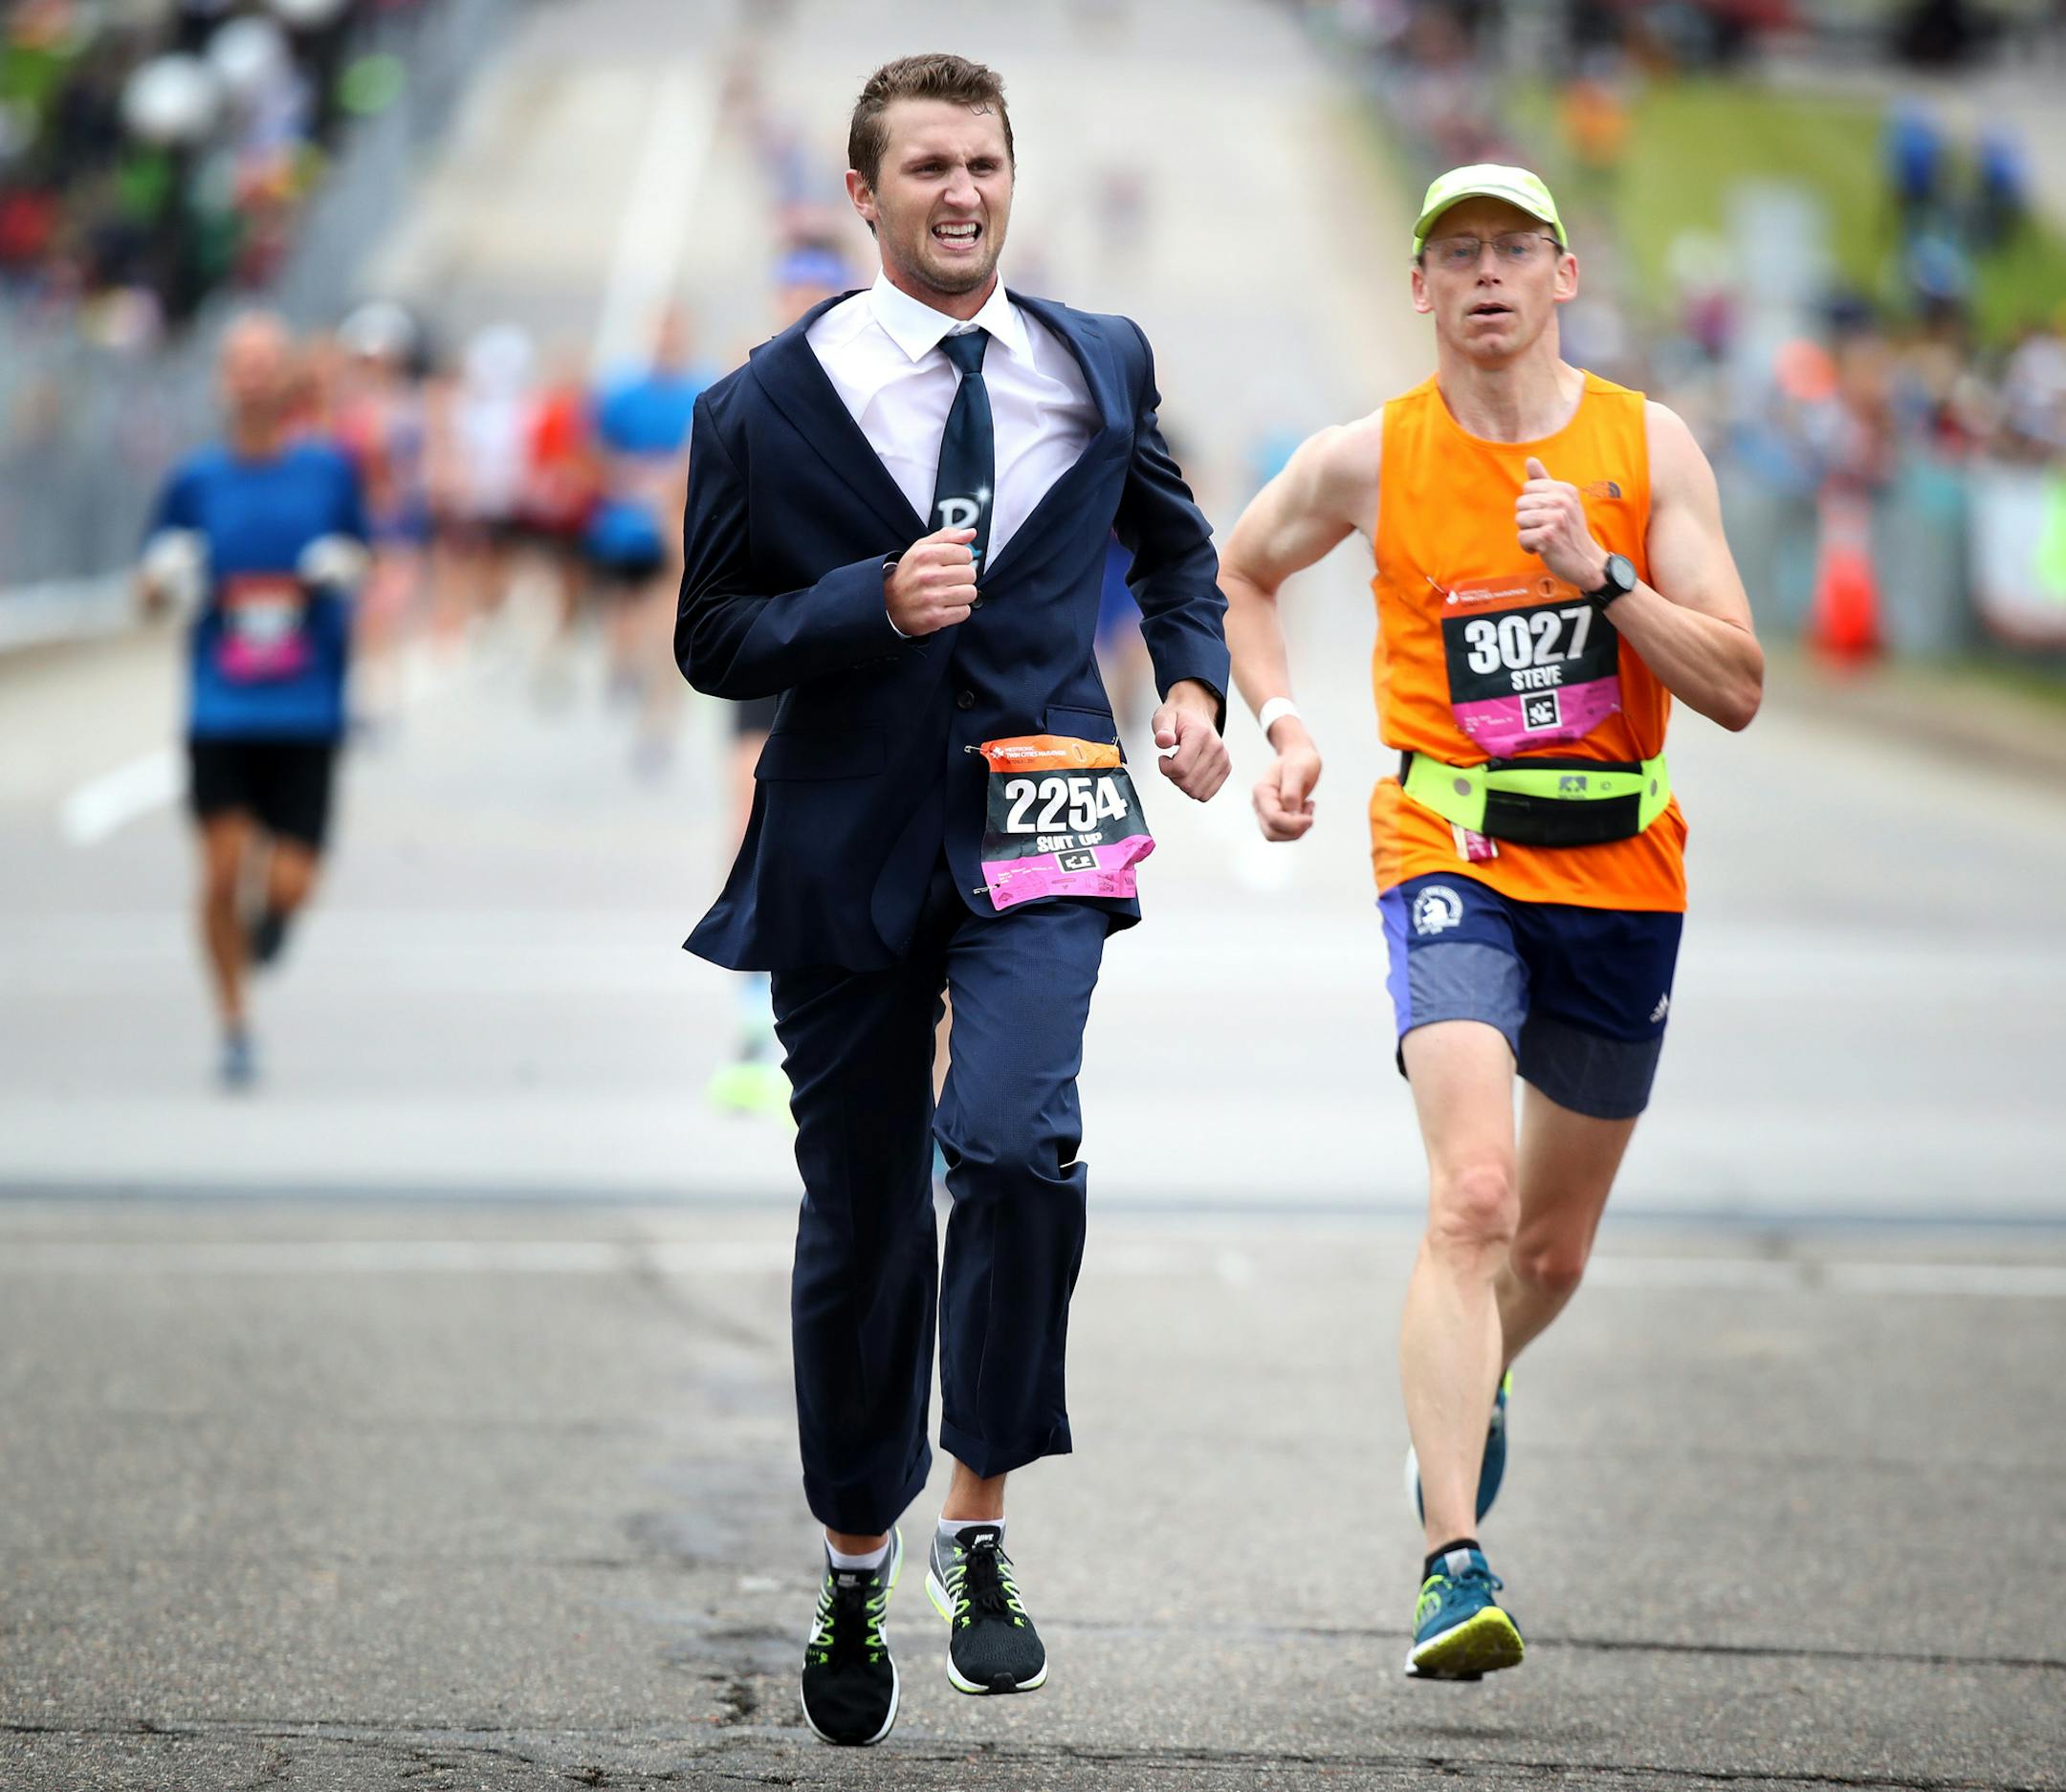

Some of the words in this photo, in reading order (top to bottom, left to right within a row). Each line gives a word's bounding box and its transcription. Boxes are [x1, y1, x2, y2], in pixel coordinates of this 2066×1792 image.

[1463, 605, 1593, 675] 3027
[1510, 665, 1564, 691] STEVE
[1004, 776, 1129, 834] 2254
[1036, 834, 1075, 853] SUIT
[1078, 831, 1104, 846] UP
